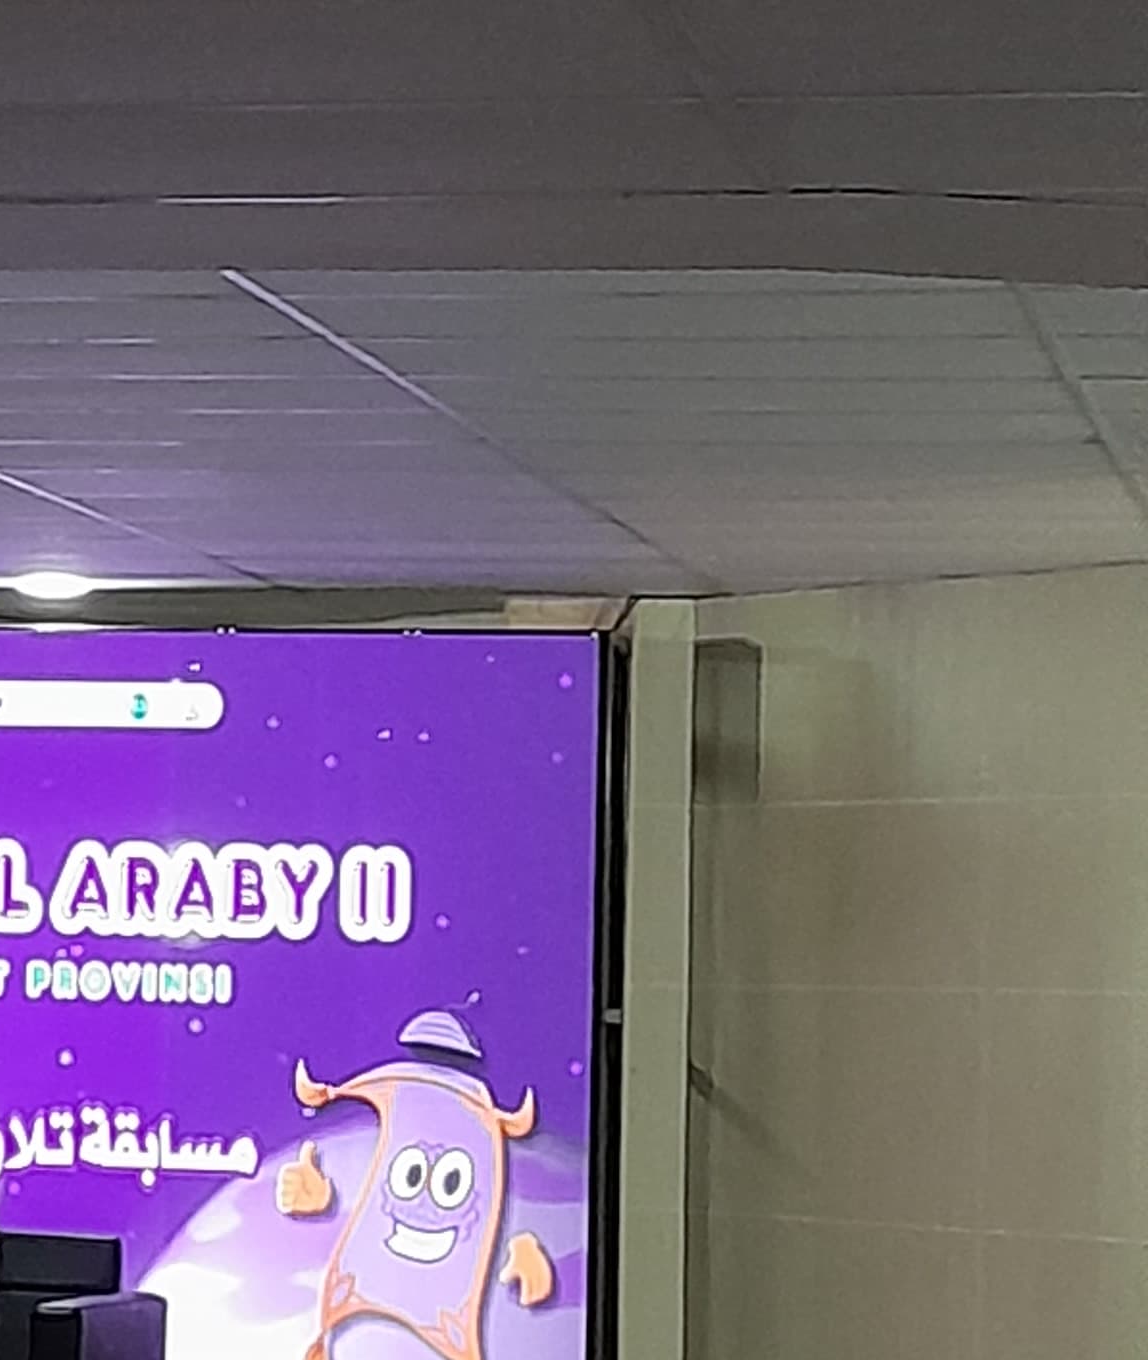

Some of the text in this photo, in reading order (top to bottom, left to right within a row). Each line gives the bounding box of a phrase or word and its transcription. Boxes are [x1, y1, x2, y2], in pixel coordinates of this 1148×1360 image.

[50, 840, 333, 939] ARABY
[26, 960, 232, 1003] PROVINSI
[78, 1106, 258, 1187] مسابقة
